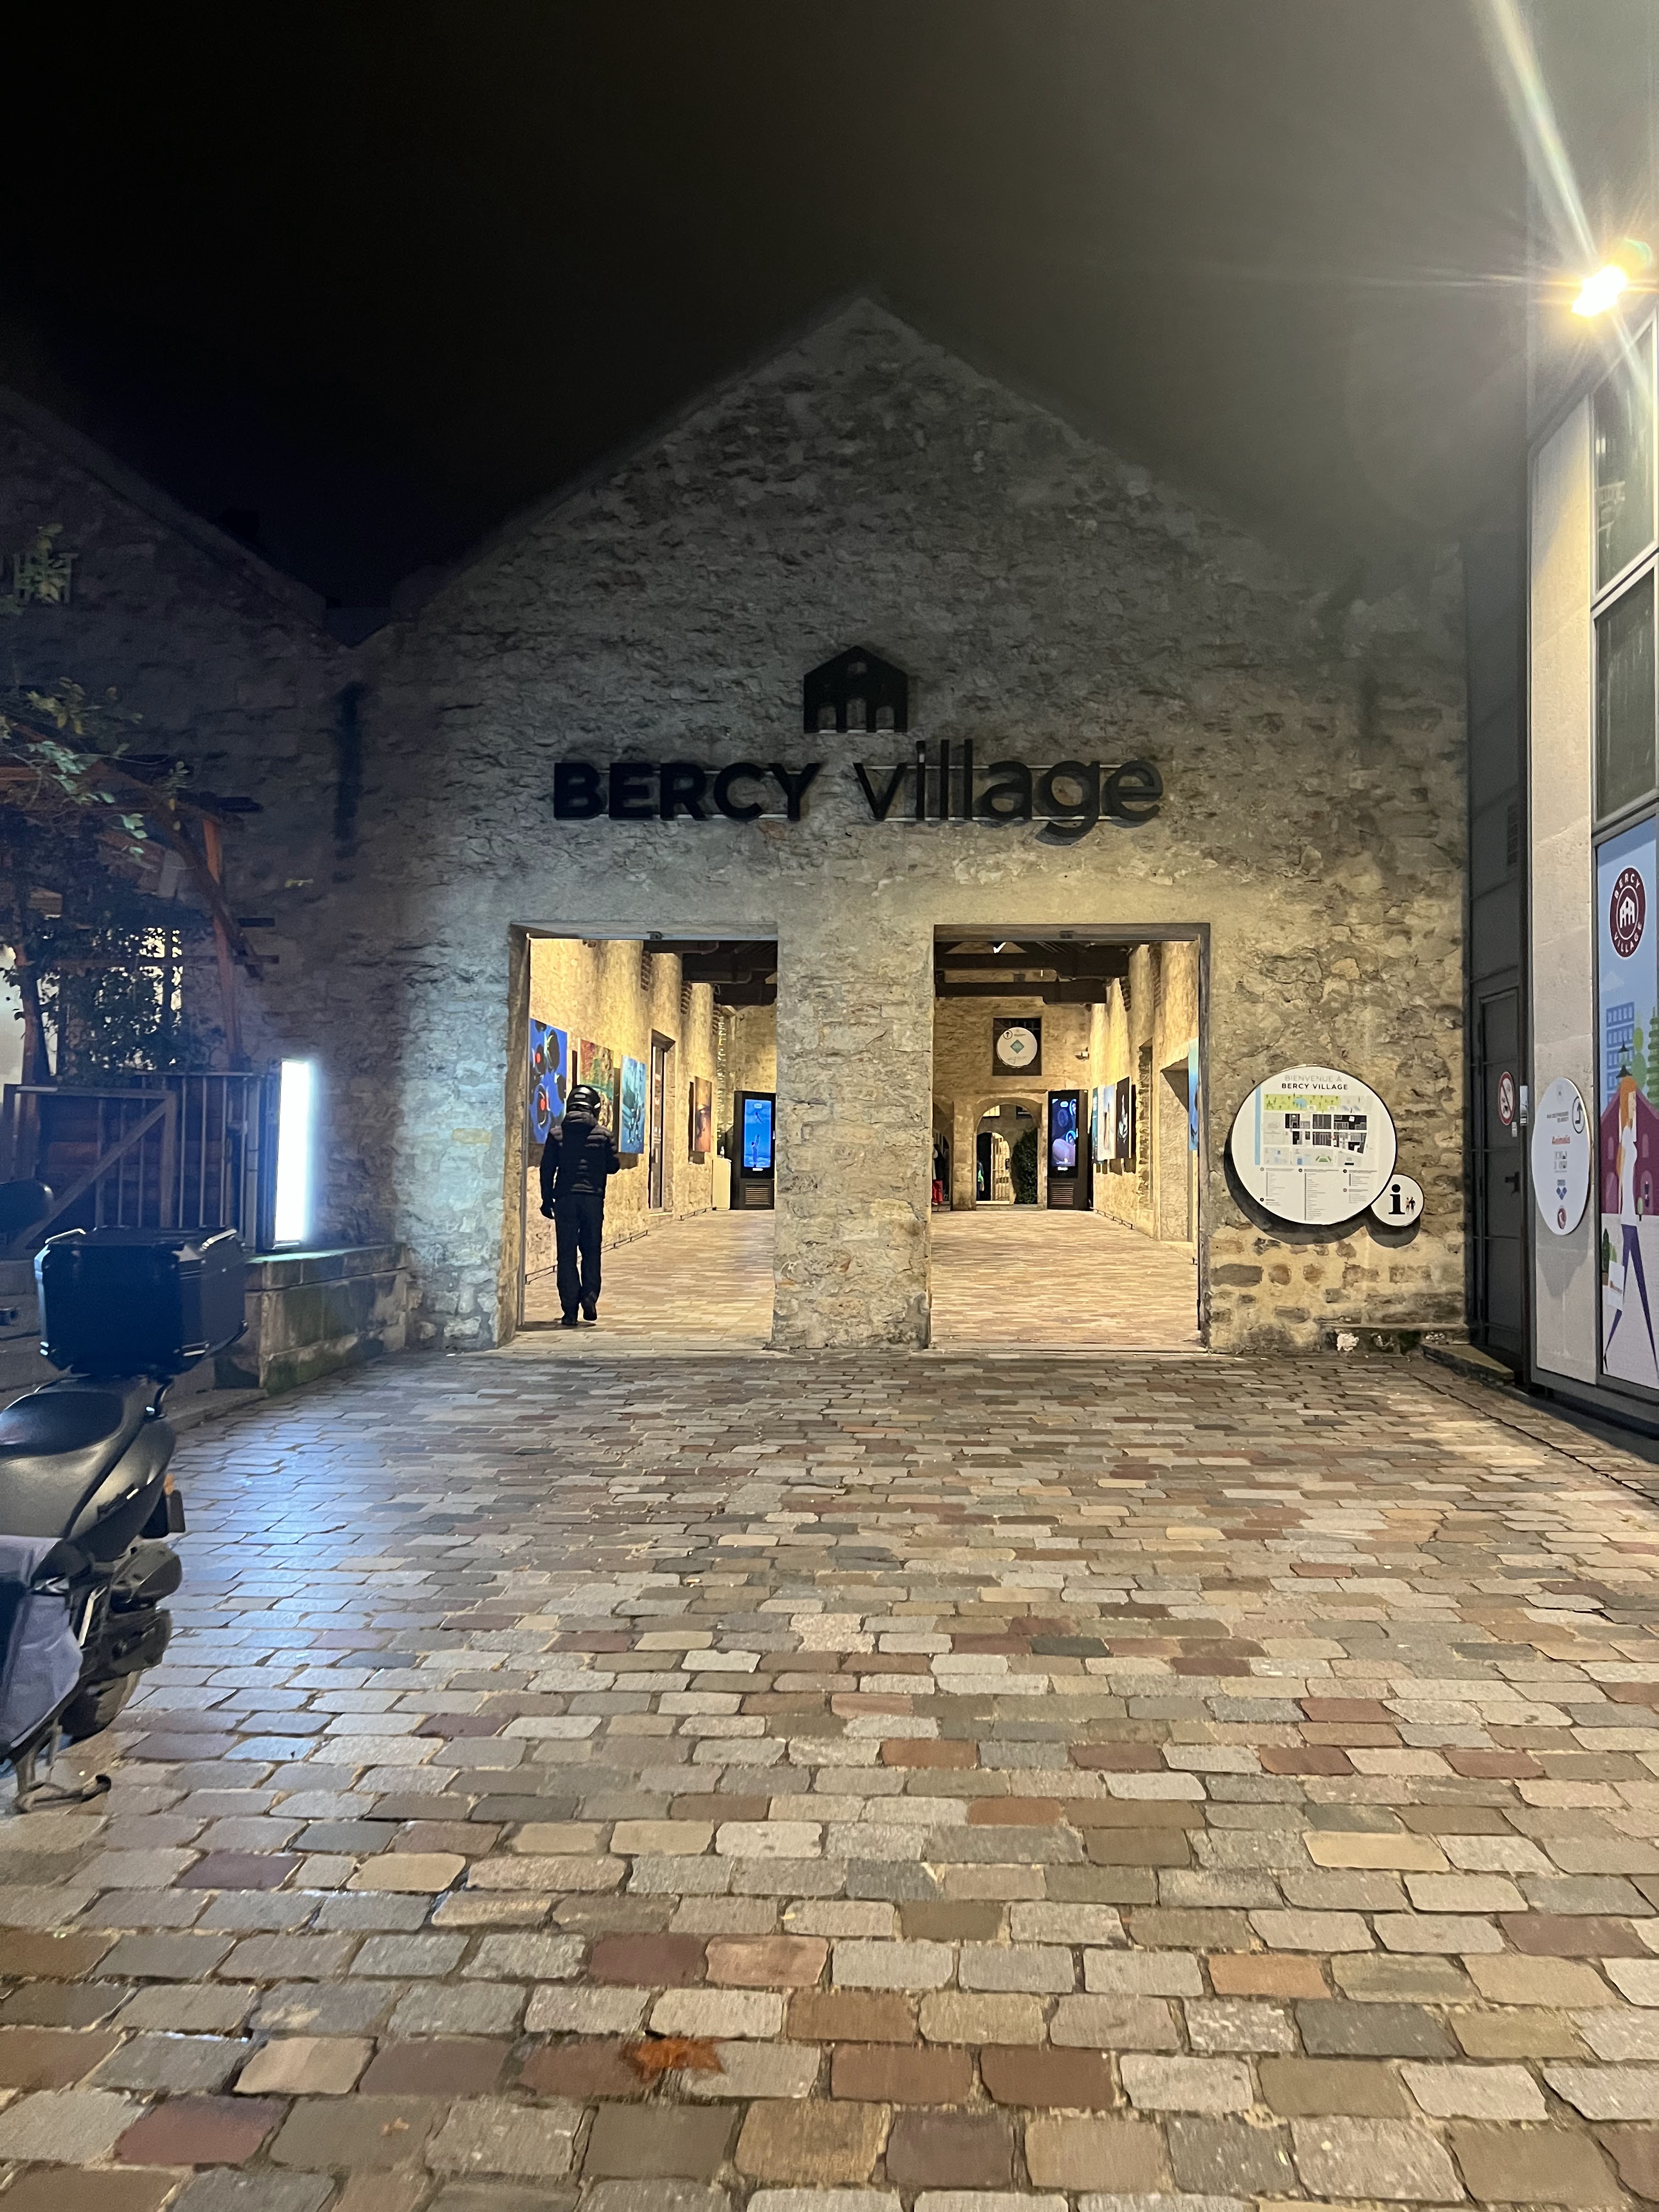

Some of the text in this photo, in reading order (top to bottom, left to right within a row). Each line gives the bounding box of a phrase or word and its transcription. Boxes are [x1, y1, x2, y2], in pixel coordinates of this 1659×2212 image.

[554, 738, 1164, 846] BERCY village
[1614, 873, 1640, 899] BERCY
[1614, 921, 1642, 953] VILLAGE
